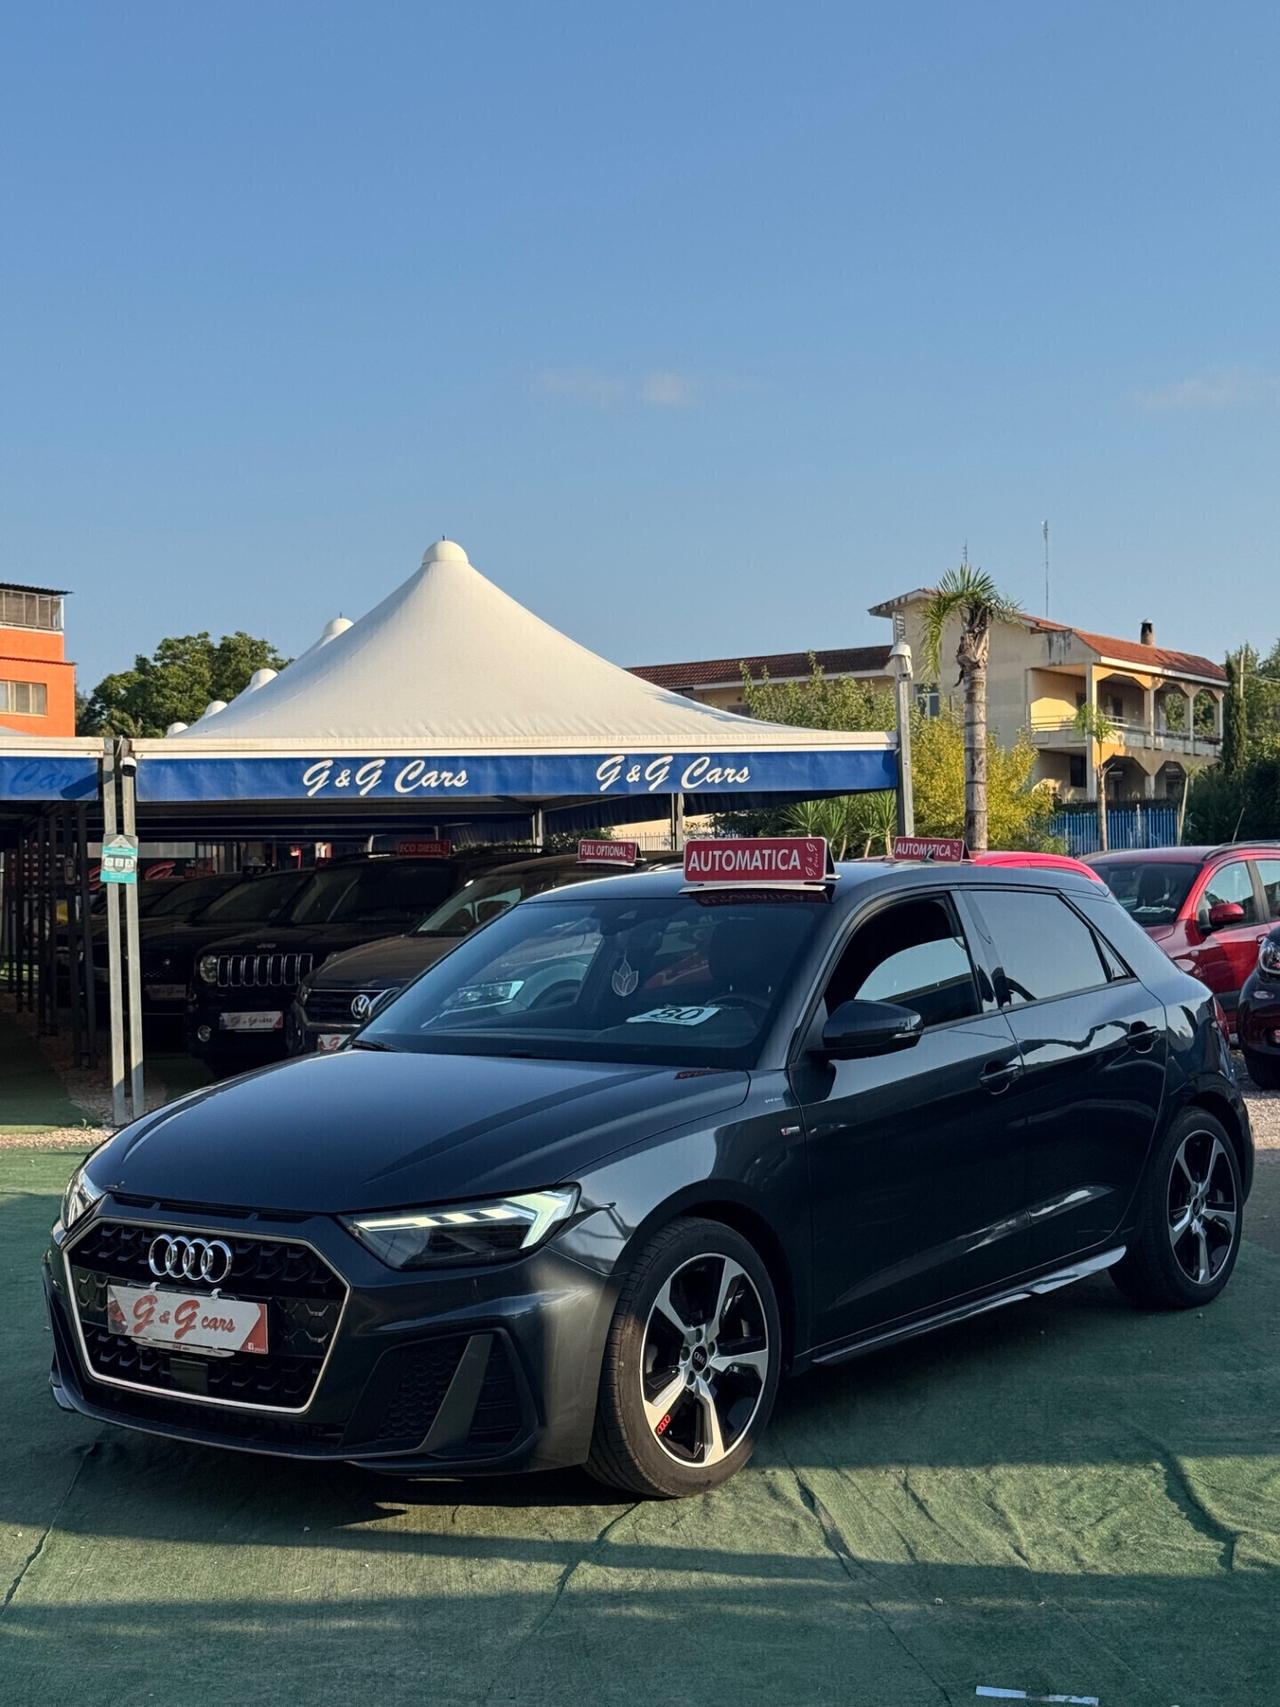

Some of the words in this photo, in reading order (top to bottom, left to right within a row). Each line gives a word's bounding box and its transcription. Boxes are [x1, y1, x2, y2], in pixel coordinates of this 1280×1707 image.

[394, 759, 469, 793] Cars
[680, 756, 751, 789] Cars
[581, 844, 595, 856] FULL
[596, 845, 627, 857] OPTIONAL
[688, 848, 801, 872] AUTOMATICA
[201, 1315, 236, 1333] cars
